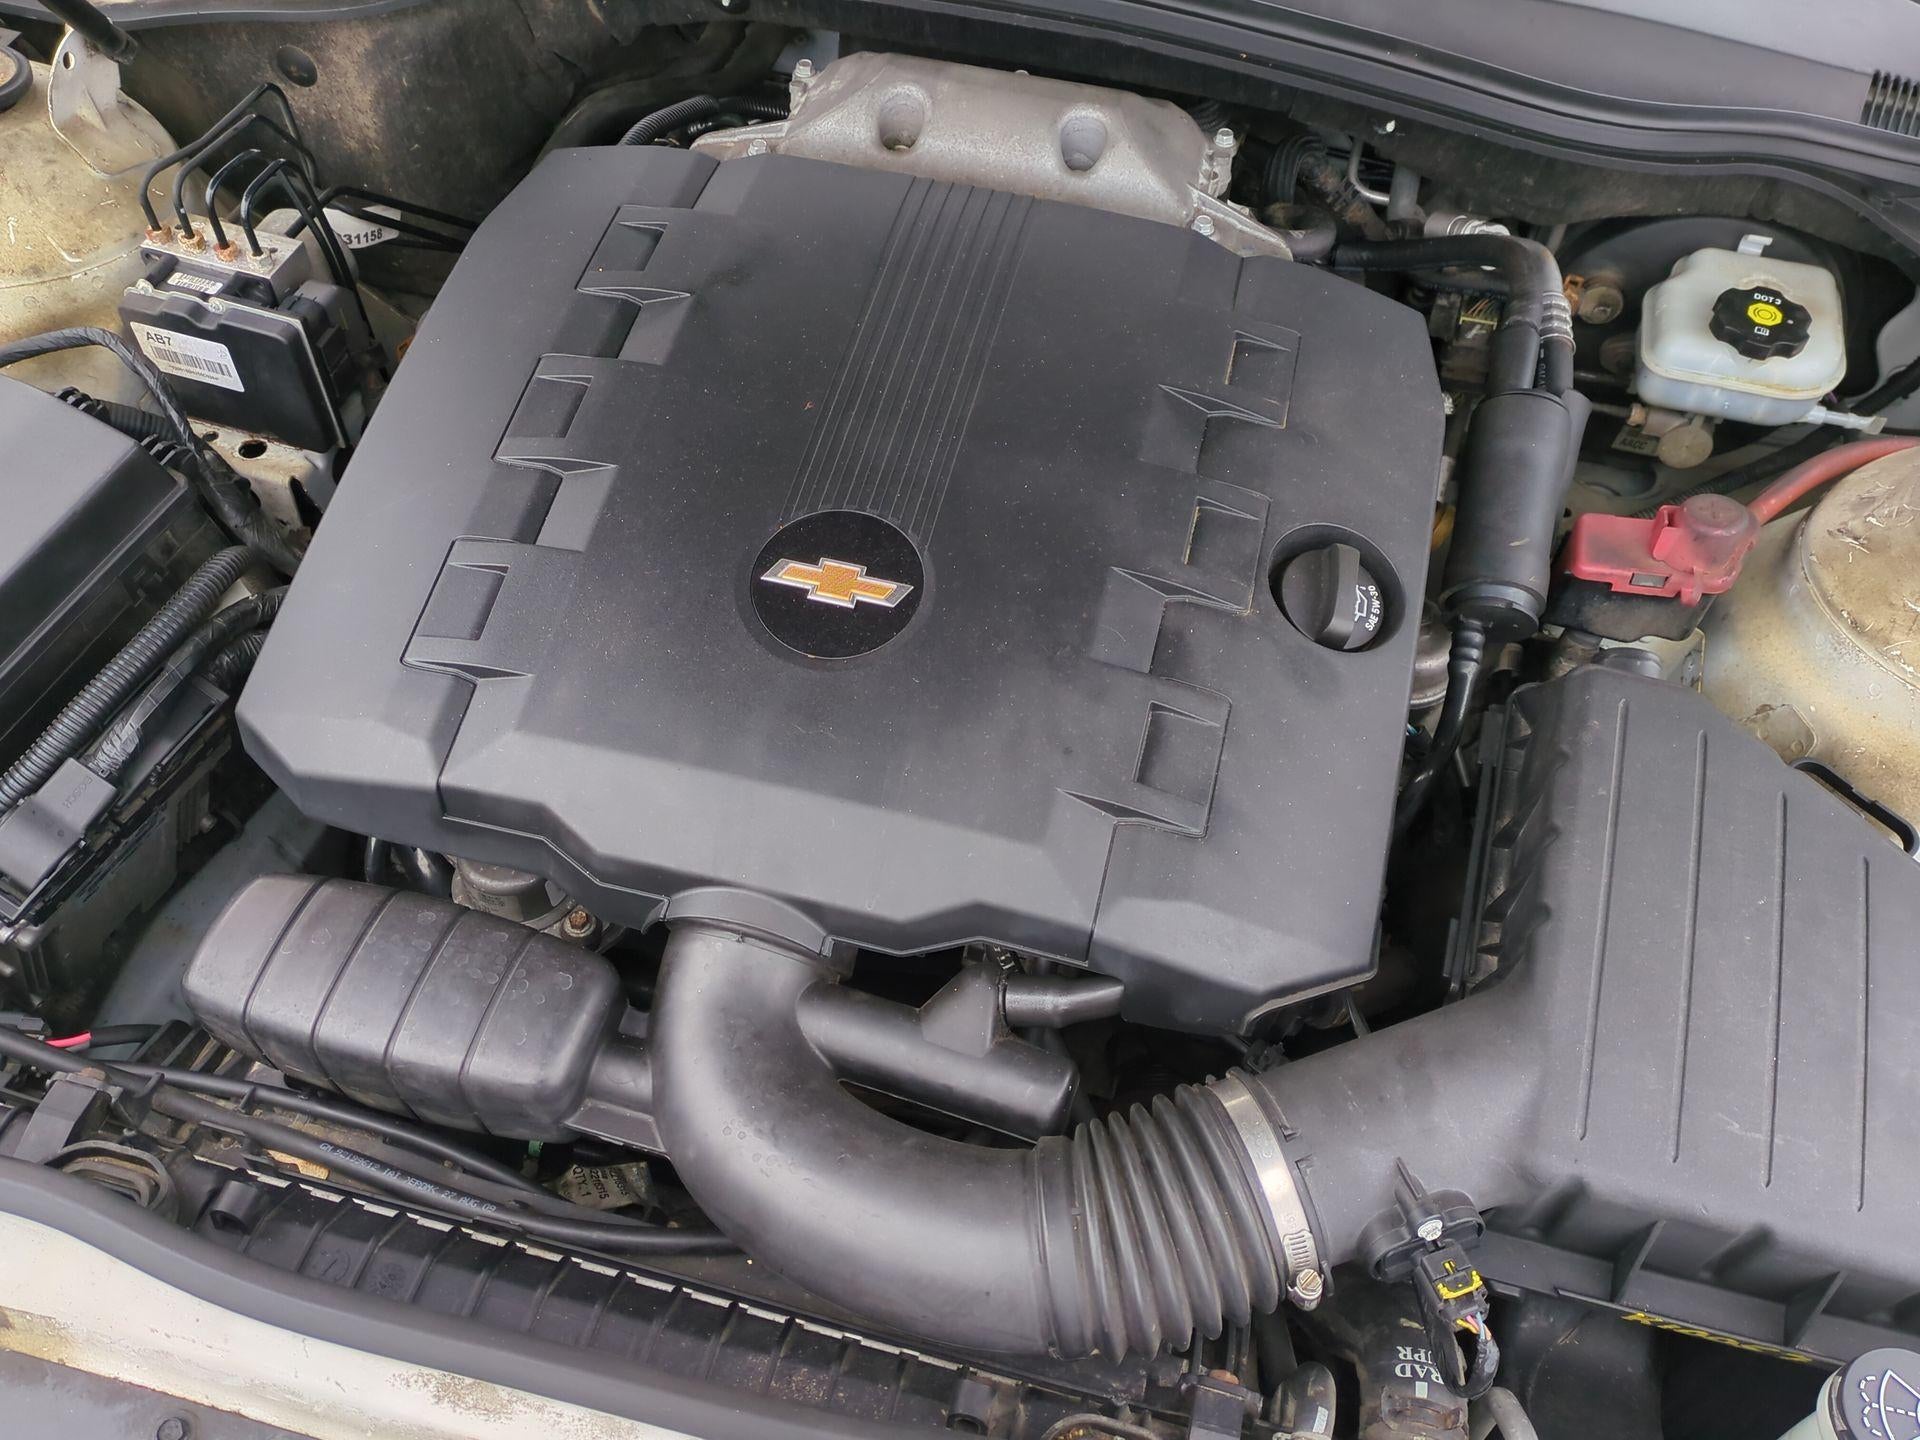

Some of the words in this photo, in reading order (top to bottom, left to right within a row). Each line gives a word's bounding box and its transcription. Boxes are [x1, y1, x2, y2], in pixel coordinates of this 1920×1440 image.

[341, 228, 383, 245] 31158
[1753, 292, 1774, 303] DOT
[146, 331, 171, 346] AB7
[1368, 585, 1381, 614] 5W-30
[1365, 614, 1379, 631] SAE
[1395, 1363, 1444, 1385] RAD
